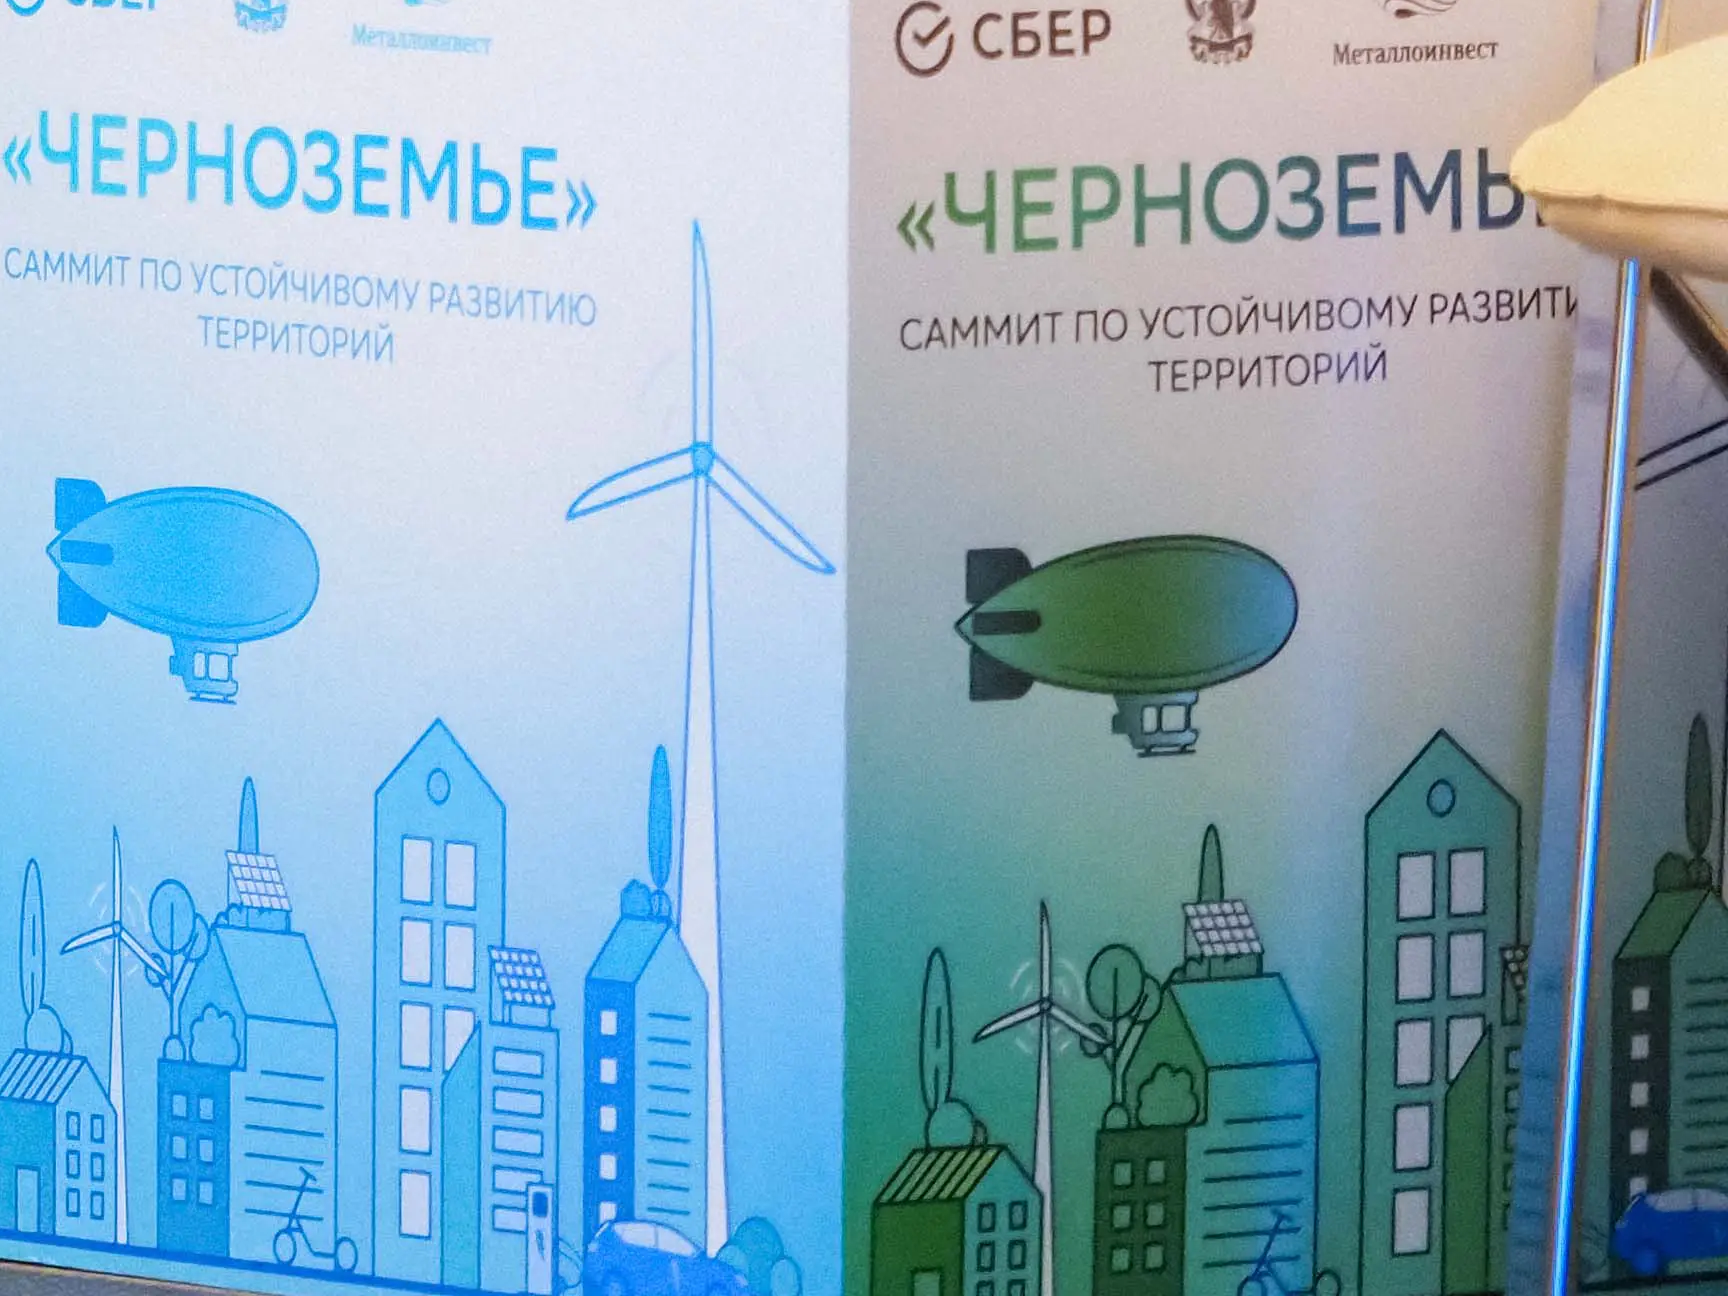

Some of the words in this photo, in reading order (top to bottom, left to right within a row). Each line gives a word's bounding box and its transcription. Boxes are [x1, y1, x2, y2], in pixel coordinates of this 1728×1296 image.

[972, 8, 1112, 60] СБЕР
[1333, 41, 1499, 69] Металлоинвест
[2, 110, 598, 231] «ЧЕРНОЗЕМЬЕ»
[897, 147, 1547, 253] «ЧЕРНОЗЕМЬ
[4, 246, 132, 286] САММИТ
[139, 257, 182, 292] ПО
[189, 260, 420, 311] УСТОЙЧИВОМУ
[429, 281, 598, 327] РАЗВИТИЮ
[197, 314, 394, 362] ТЕРРИТОРИЙ
[899, 311, 1063, 351] САММИТ
[1075, 308, 1129, 343] ПО
[1139, 293, 1419, 340] УСТОЙЧИВОМУ
[1429, 284, 1579, 325] РАЗВИТИ
[1147, 344, 1387, 393] ТЕРРИТОРИЙ
